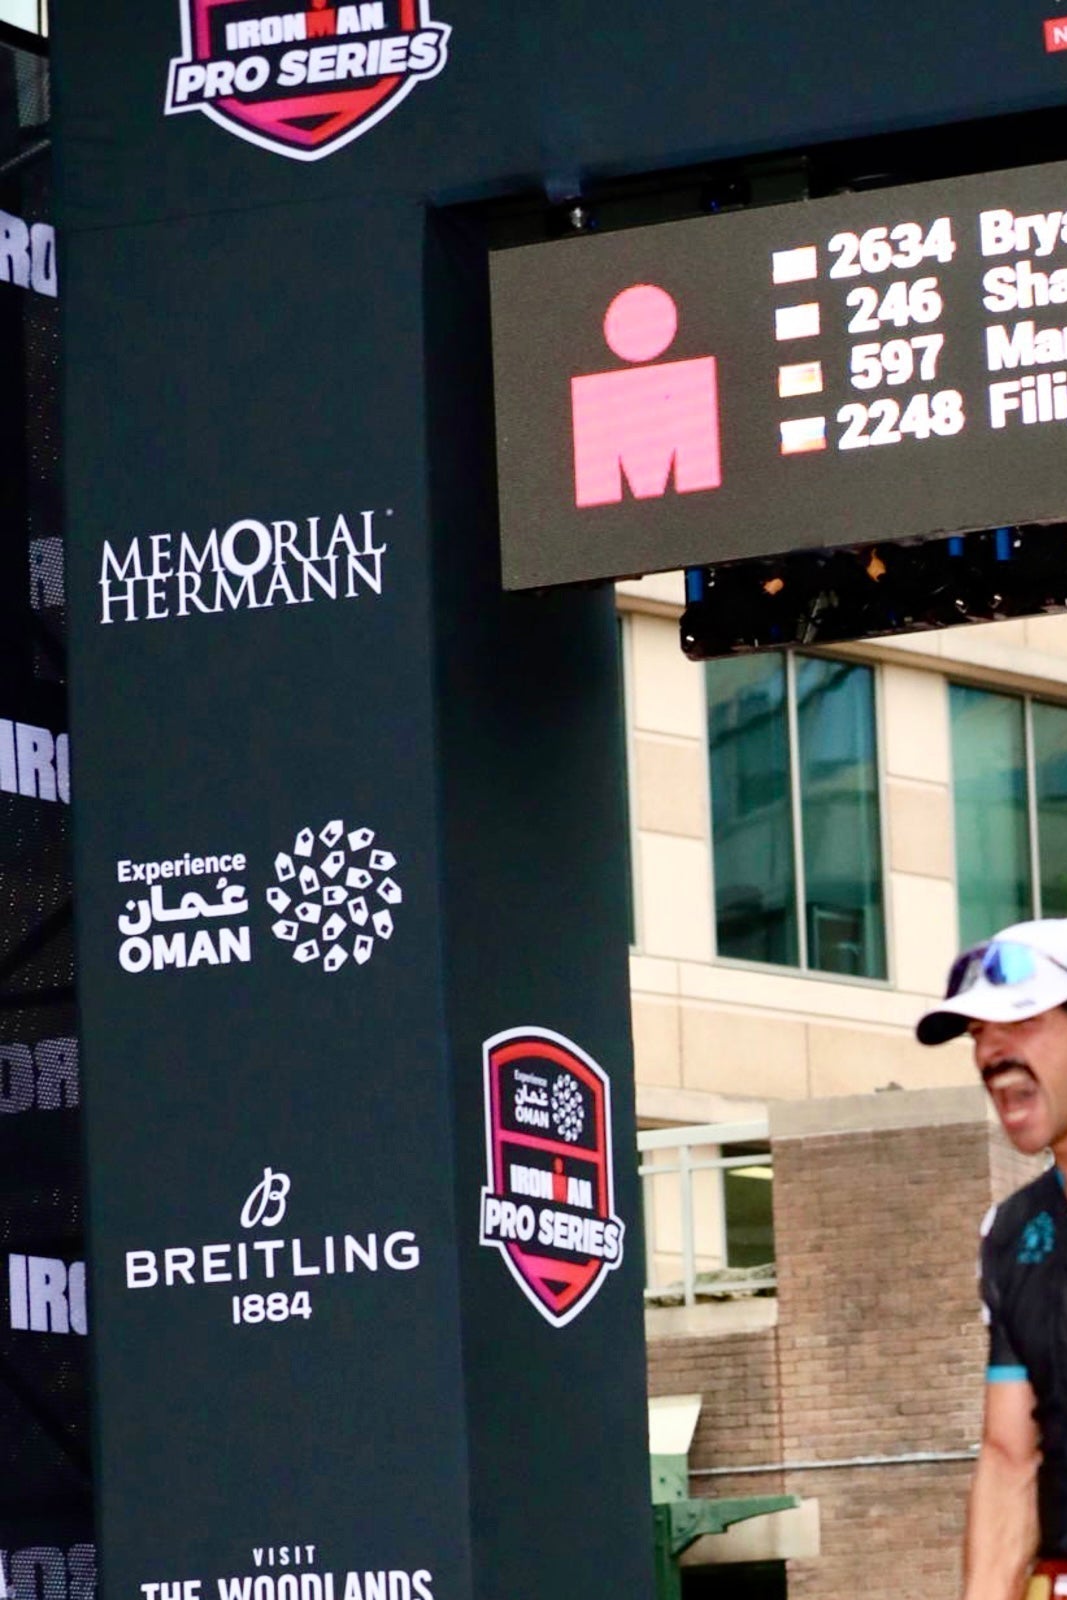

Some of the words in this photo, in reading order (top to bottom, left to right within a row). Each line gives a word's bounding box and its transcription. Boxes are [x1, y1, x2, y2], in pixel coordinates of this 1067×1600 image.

[176, 56, 270, 102] PRO
[276, 32, 439, 87] SERIES
[828, 218, 955, 280] 2634
[846, 278, 942, 333] 246
[849, 334, 944, 389] 597
[837, 389, 965, 450] 2248
[98, 510, 387, 584] MEMORIAL
[100, 551, 382, 624] HERMANN
[117, 853, 246, 885] Experience
[119, 926, 251, 973] OMAN
[515, 1106, 549, 1129] OMAN
[485, 1199, 536, 1242] PRO
[538, 1209, 620, 1260] SERIES
[126, 1231, 420, 1288] BREITLING
[233, 1291, 312, 1324] 1884
[252, 1545, 315, 1567] VISIT
